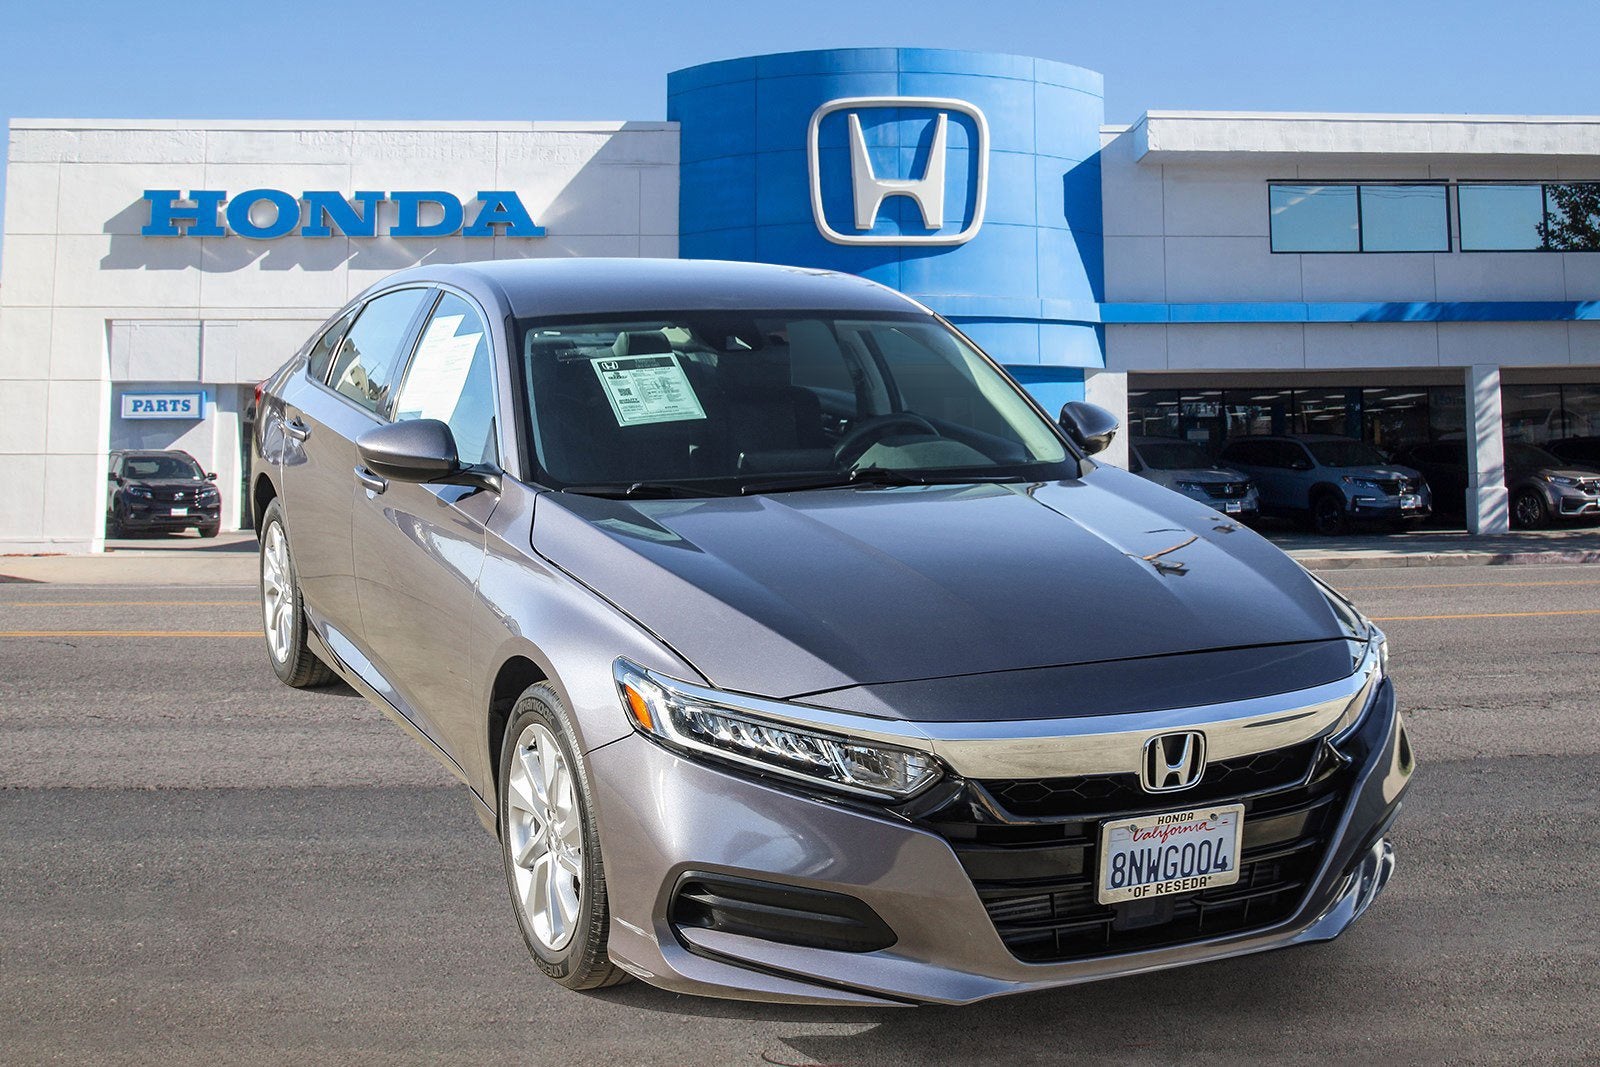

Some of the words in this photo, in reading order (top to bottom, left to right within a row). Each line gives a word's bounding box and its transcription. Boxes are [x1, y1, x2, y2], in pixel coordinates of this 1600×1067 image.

[142, 189, 547, 239] HONDA
[132, 399, 191, 412] PARTS
[1157, 812, 1194, 825] HONDA
[1132, 820, 1216, 844] California
[1110, 838, 1228, 889] 8NWG004
[1134, 886, 1151, 898] OF
[1156, 877, 1207, 895] RESEDA
